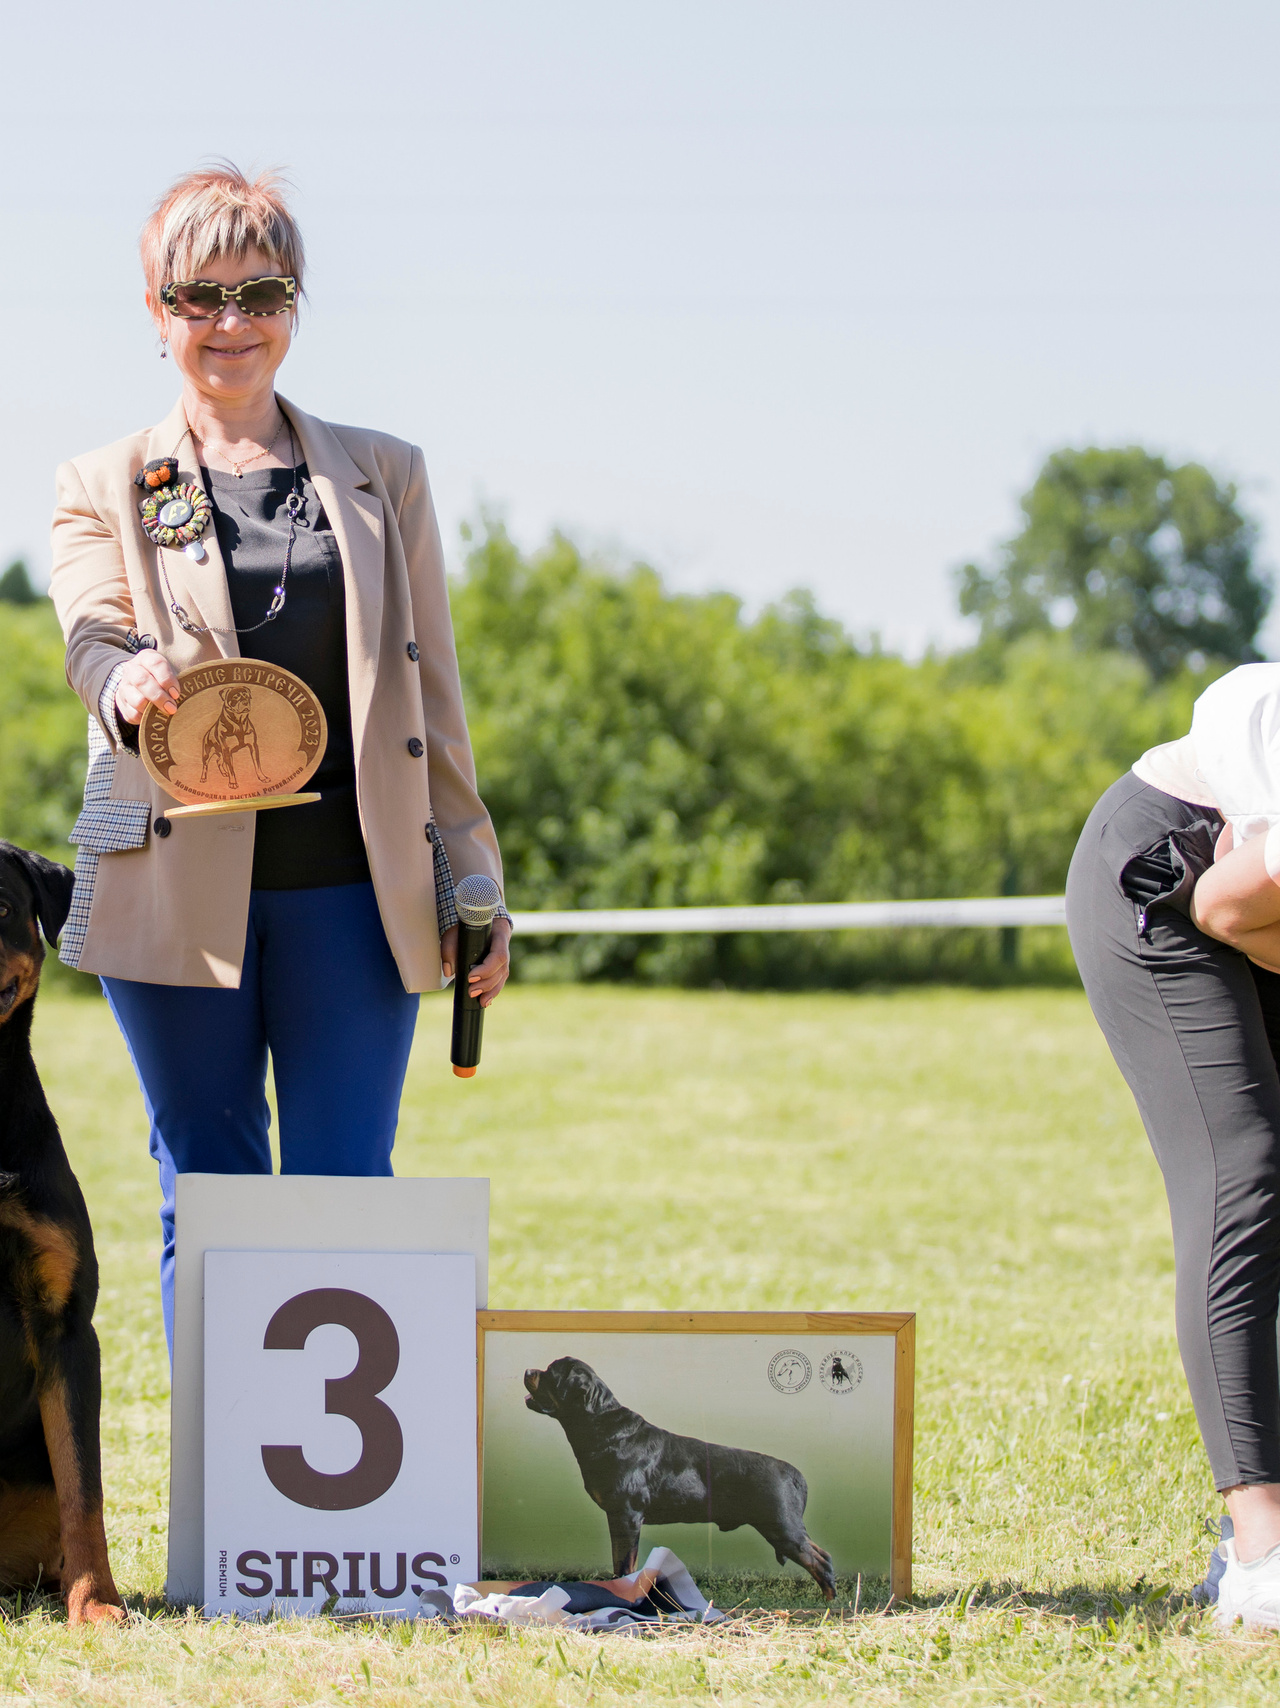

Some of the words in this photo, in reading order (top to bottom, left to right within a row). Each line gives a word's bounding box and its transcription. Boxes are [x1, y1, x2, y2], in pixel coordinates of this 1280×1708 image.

[149, 668, 226, 763] ВОРОНСКИЕ
[232, 667, 308, 708] ВСТРЕЧИ
[301, 709, 320, 746] 2023
[261, 1287, 404, 1511] 3
[219, 1550, 228, 1597] PREMIUM
